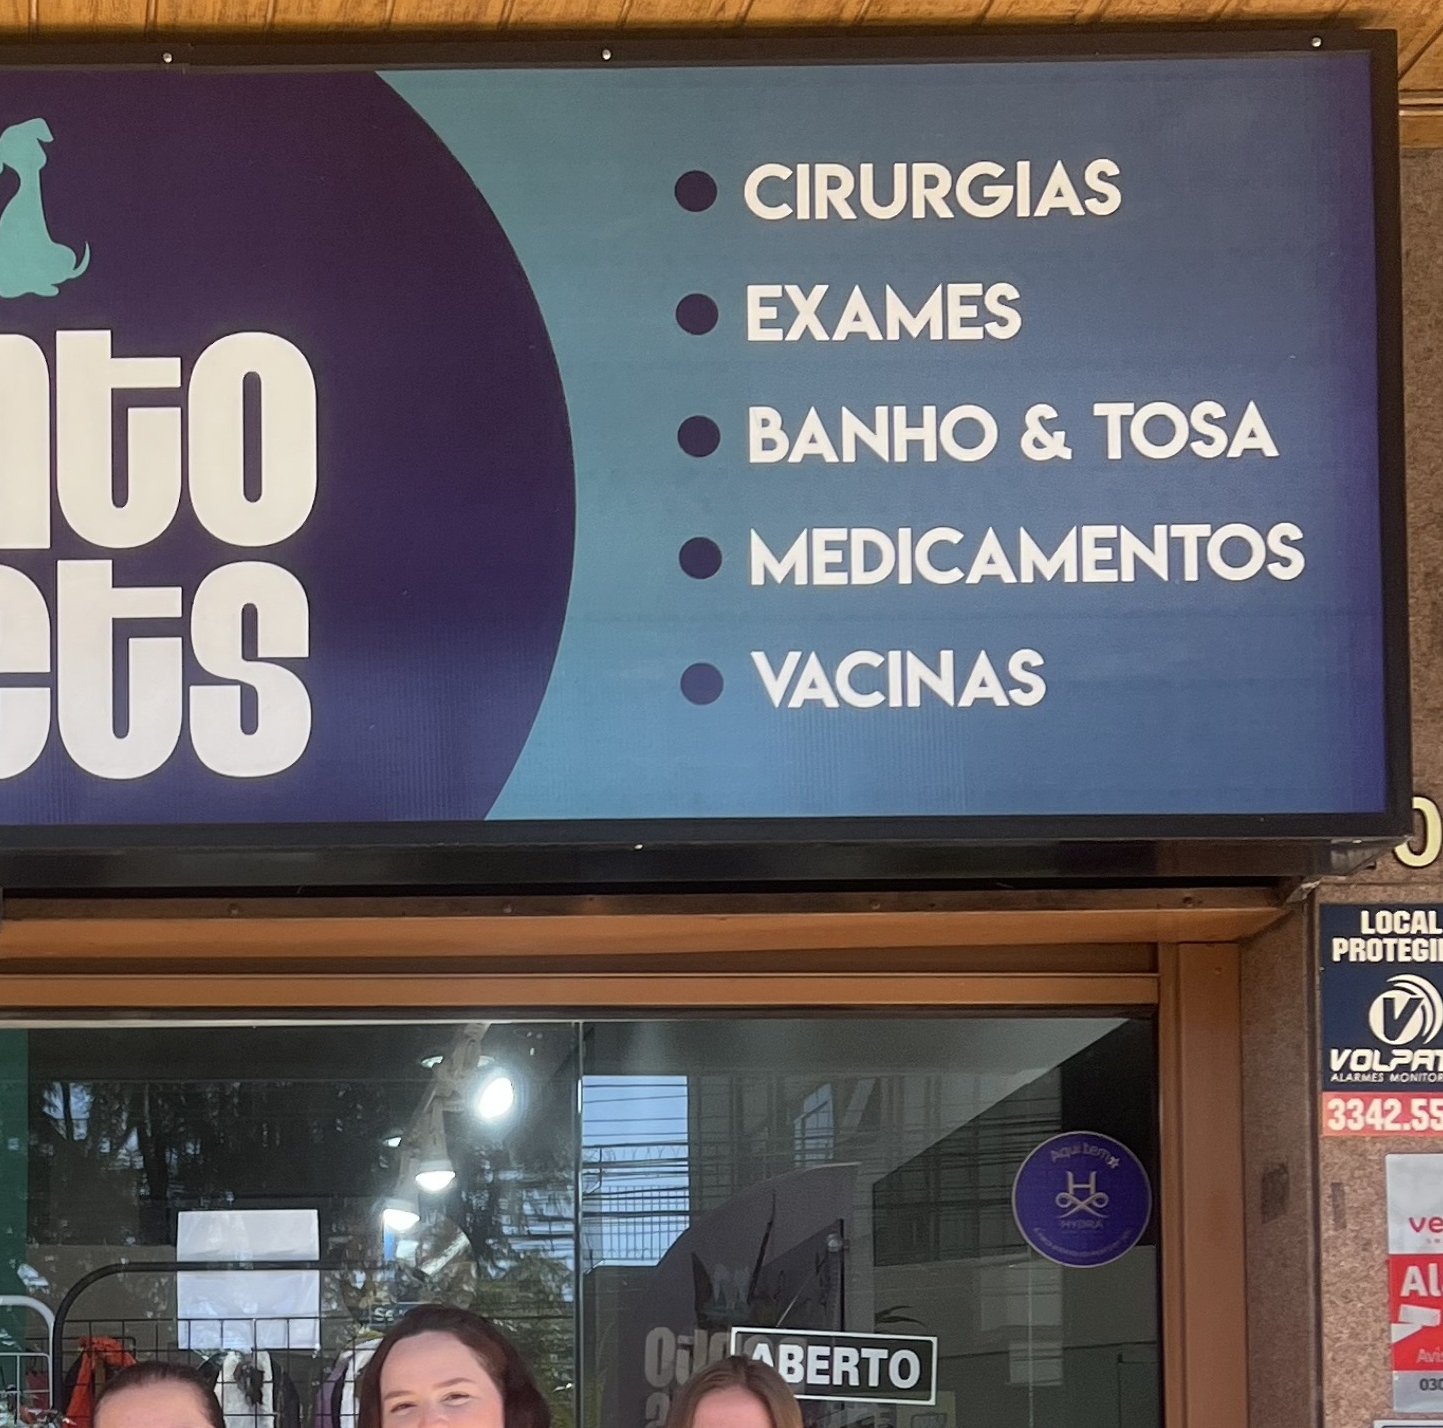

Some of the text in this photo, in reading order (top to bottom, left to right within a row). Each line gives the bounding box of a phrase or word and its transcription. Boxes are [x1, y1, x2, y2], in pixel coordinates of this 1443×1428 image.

[744, 159, 1122, 220] CIRURGIAS
[746, 282, 1022, 341] EXAMES
[749, 401, 1279, 463] BANHO & TOSA
[751, 522, 1305, 585] MEDICAMENTOS
[751, 649, 1047, 708] VACINAS
[1361, 910, 1443, 934] LOCAL
[1330, 1073, 1384, 1082] ALARMES
[1399, 1262, 1443, 1297] Al
